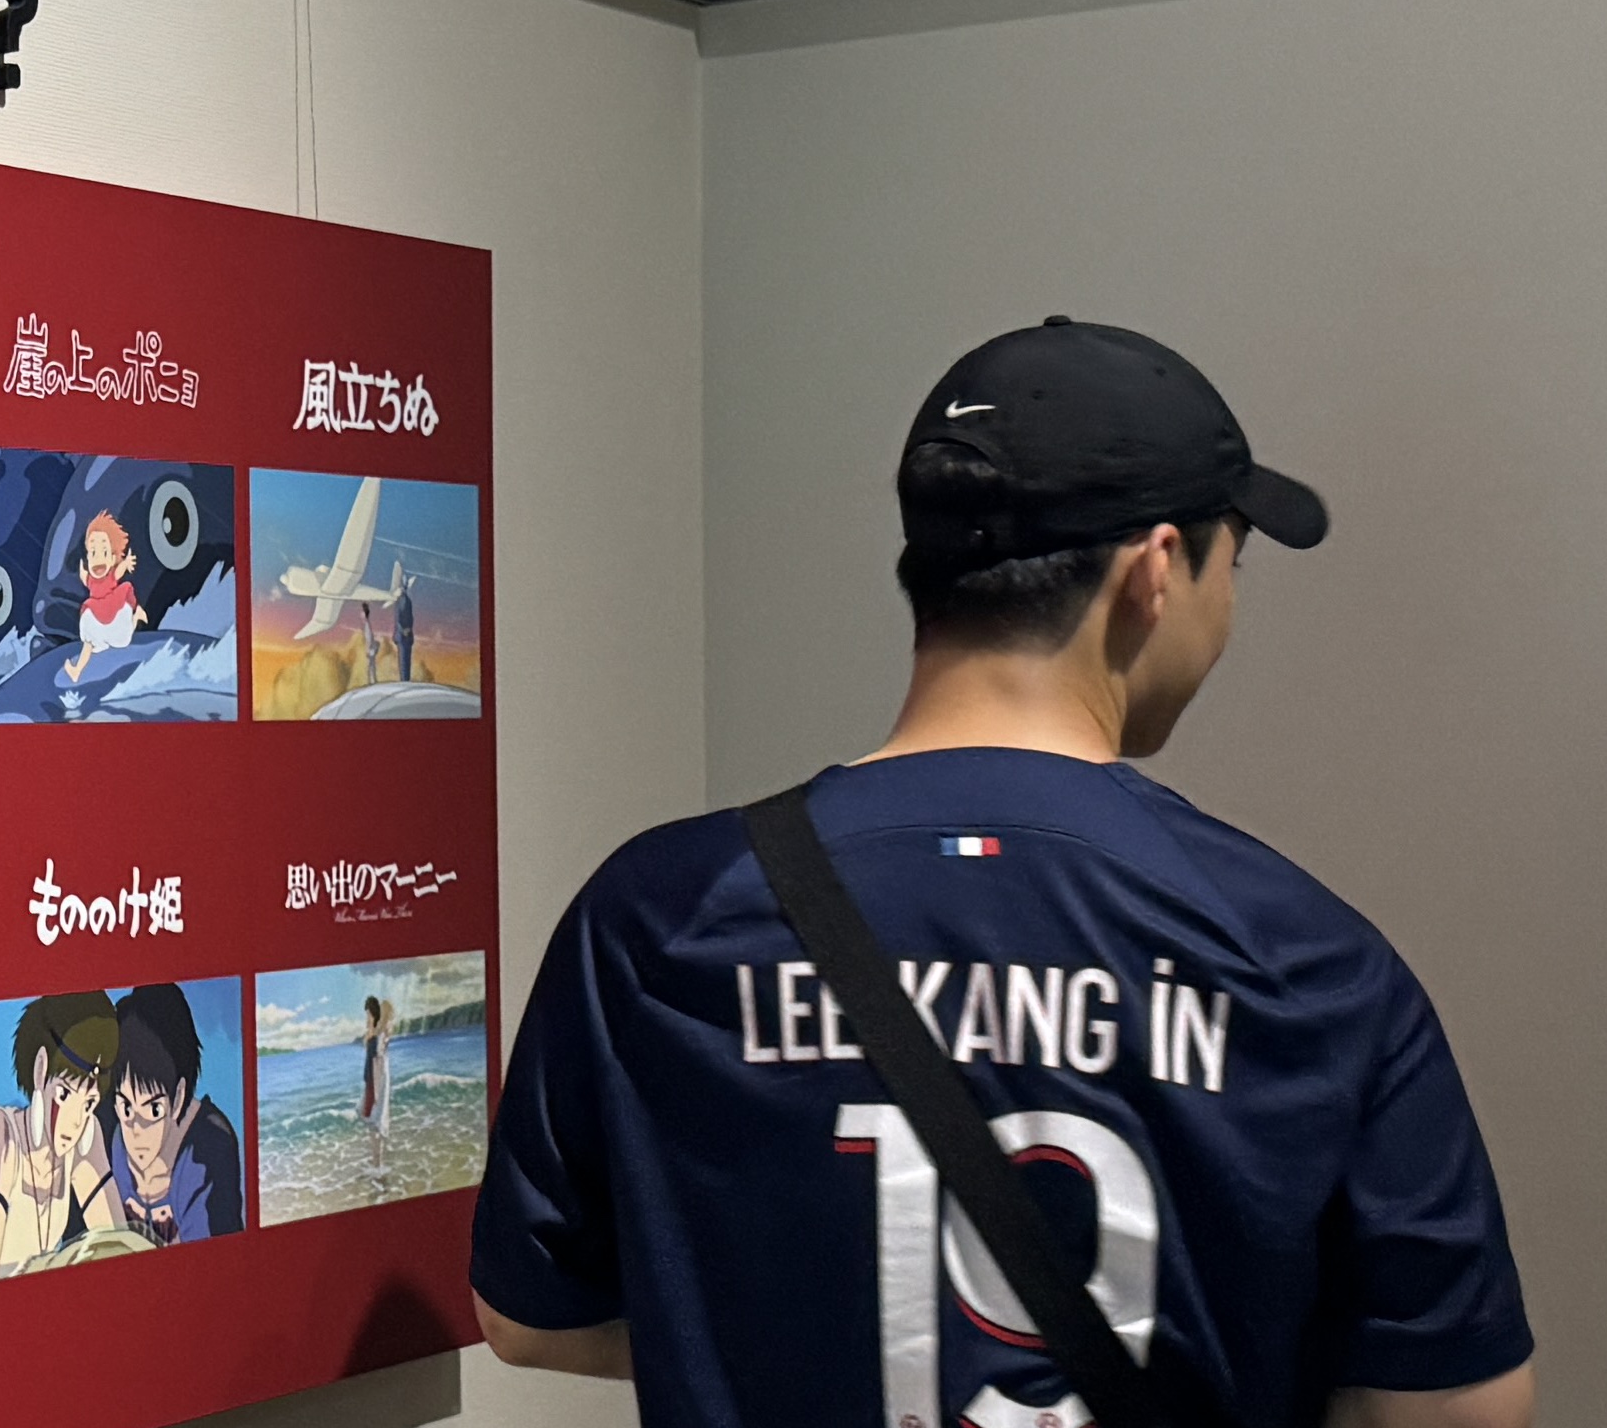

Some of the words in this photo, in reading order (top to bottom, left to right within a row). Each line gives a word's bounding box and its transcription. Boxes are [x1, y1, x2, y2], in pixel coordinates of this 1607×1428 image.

[3, 313, 200, 409] 崖の上のポニョ
[293, 359, 440, 437] 風立ちぬ
[29, 858, 184, 946] もののけ姫
[285, 859, 458, 910] 思い出のマーニー
[736, 961, 864, 1063] LEE
[899, 960, 1119, 1074] KANG
